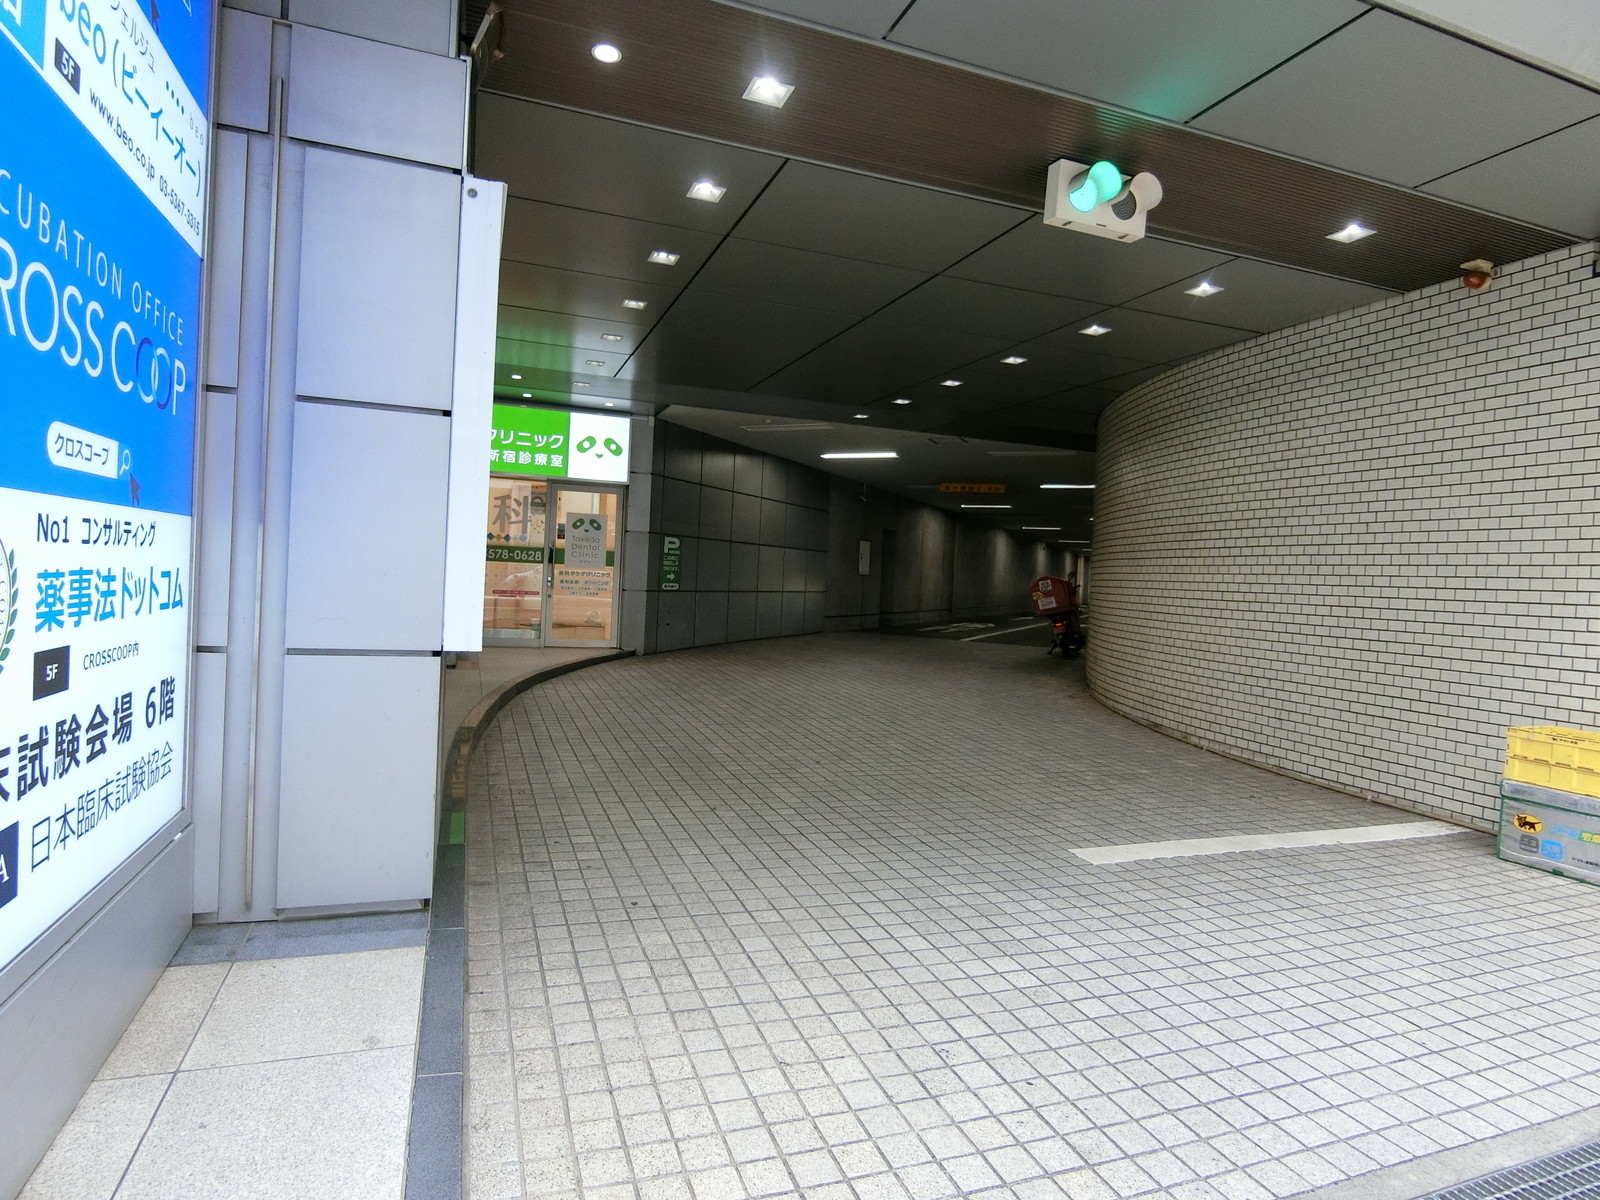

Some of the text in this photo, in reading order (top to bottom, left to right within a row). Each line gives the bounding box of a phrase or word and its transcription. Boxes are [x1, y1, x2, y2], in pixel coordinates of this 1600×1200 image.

[60, 53, 76, 81] 5F
[89, 87, 200, 236] www.beo.co.jp 03-5367-3315
[131, 281, 184, 346] OFFICE
[54, 432, 110, 467] クロスコープ
[36, 512, 157, 547] No1 コンサルティング
[492, 494, 532, 534] 科
[487, 548, 542, 561] 578-0628
[570, 551, 599, 559] Clinic
[571, 535, 600, 544] Takeda
[571, 543, 600, 551] Dental
[34, 566, 184, 634] 薬事法ドットコム
[45, 663, 59, 681] 5F
[82, 641, 139, 670] CROSSCOOP内
[145, 675, 176, 729] 6階
[31, 740, 174, 872] 日本臨床試験協会
